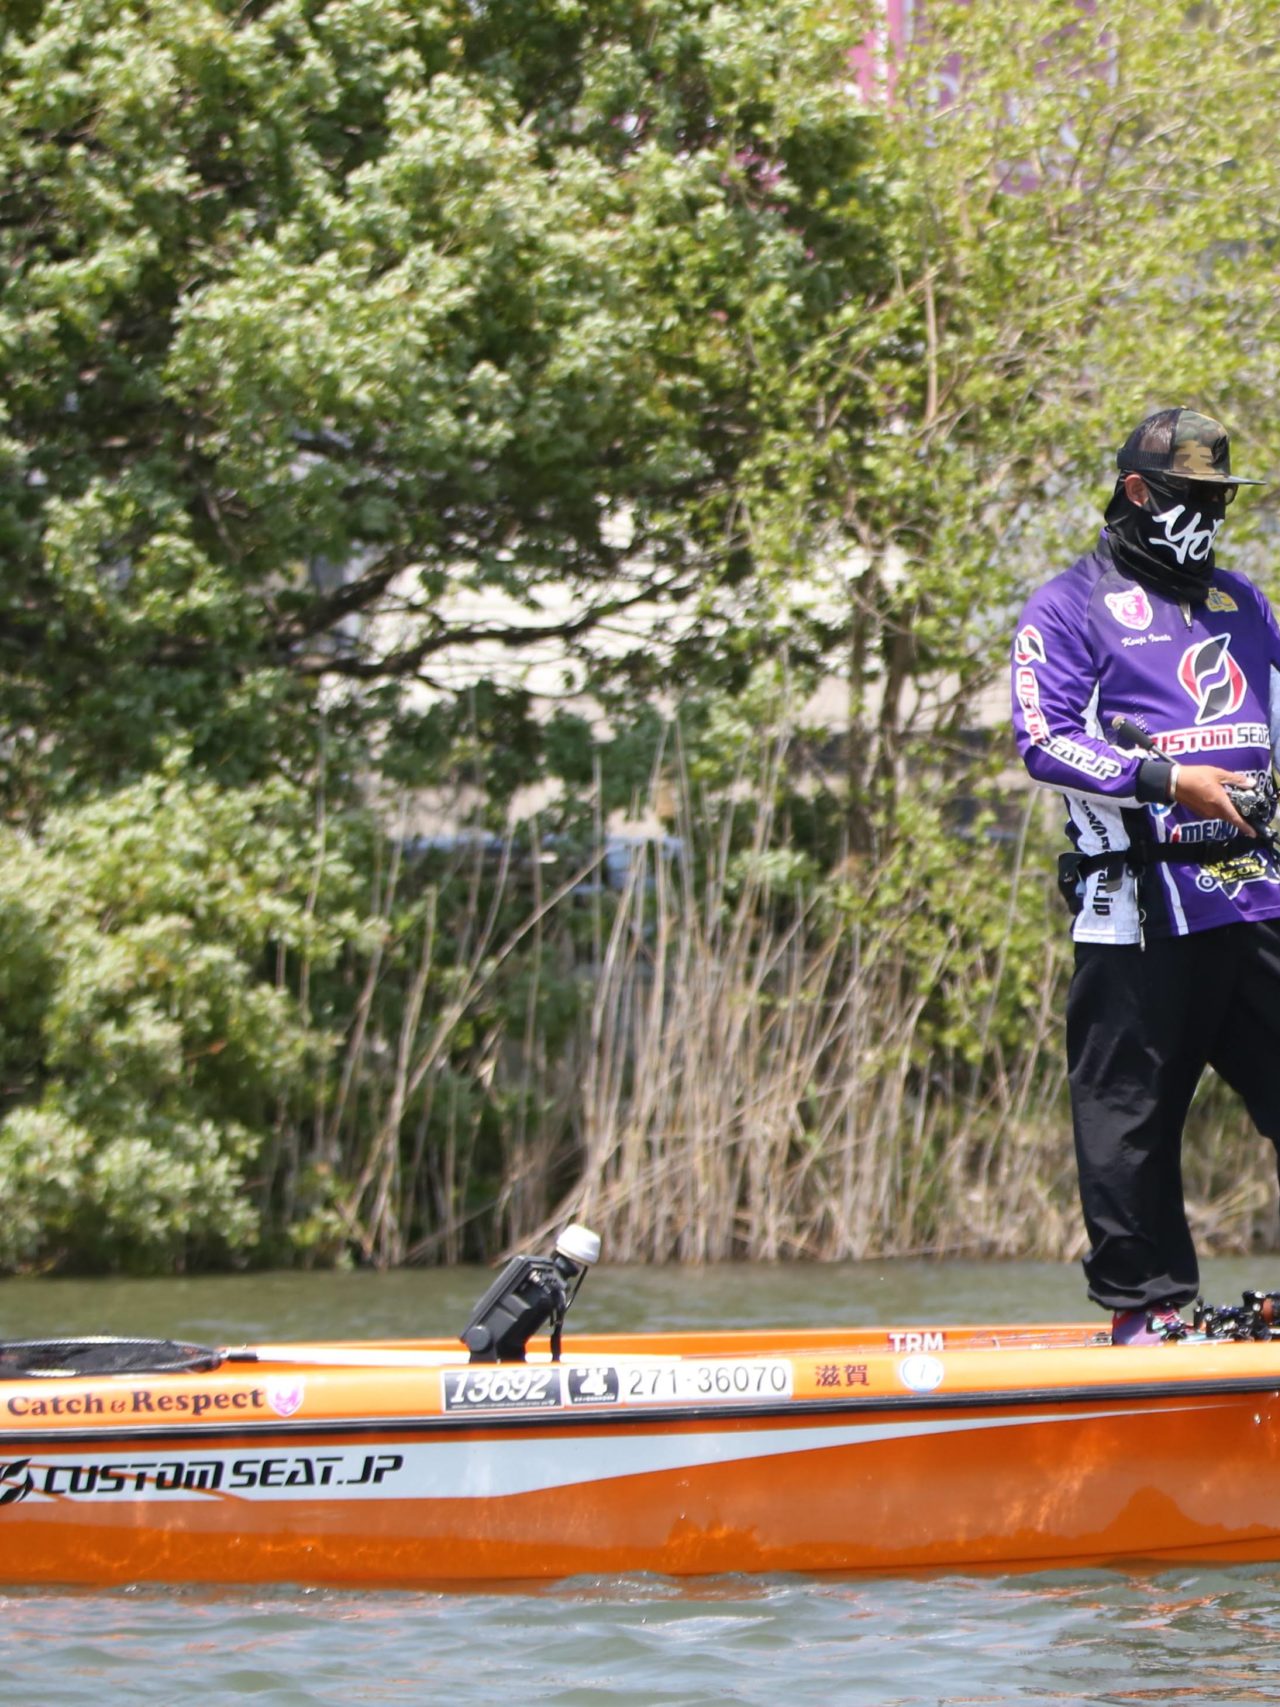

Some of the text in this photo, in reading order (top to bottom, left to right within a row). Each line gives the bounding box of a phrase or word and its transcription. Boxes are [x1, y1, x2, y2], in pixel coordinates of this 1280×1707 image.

[888, 1332, 944, 1353] TRM
[450, 1371, 553, 1403] 13692
[815, 1363, 870, 1387] 滋賀
[7, 1388, 265, 1416] Catch & Respect
[43, 1454, 404, 1494] CUSTOM SEAT.JP
